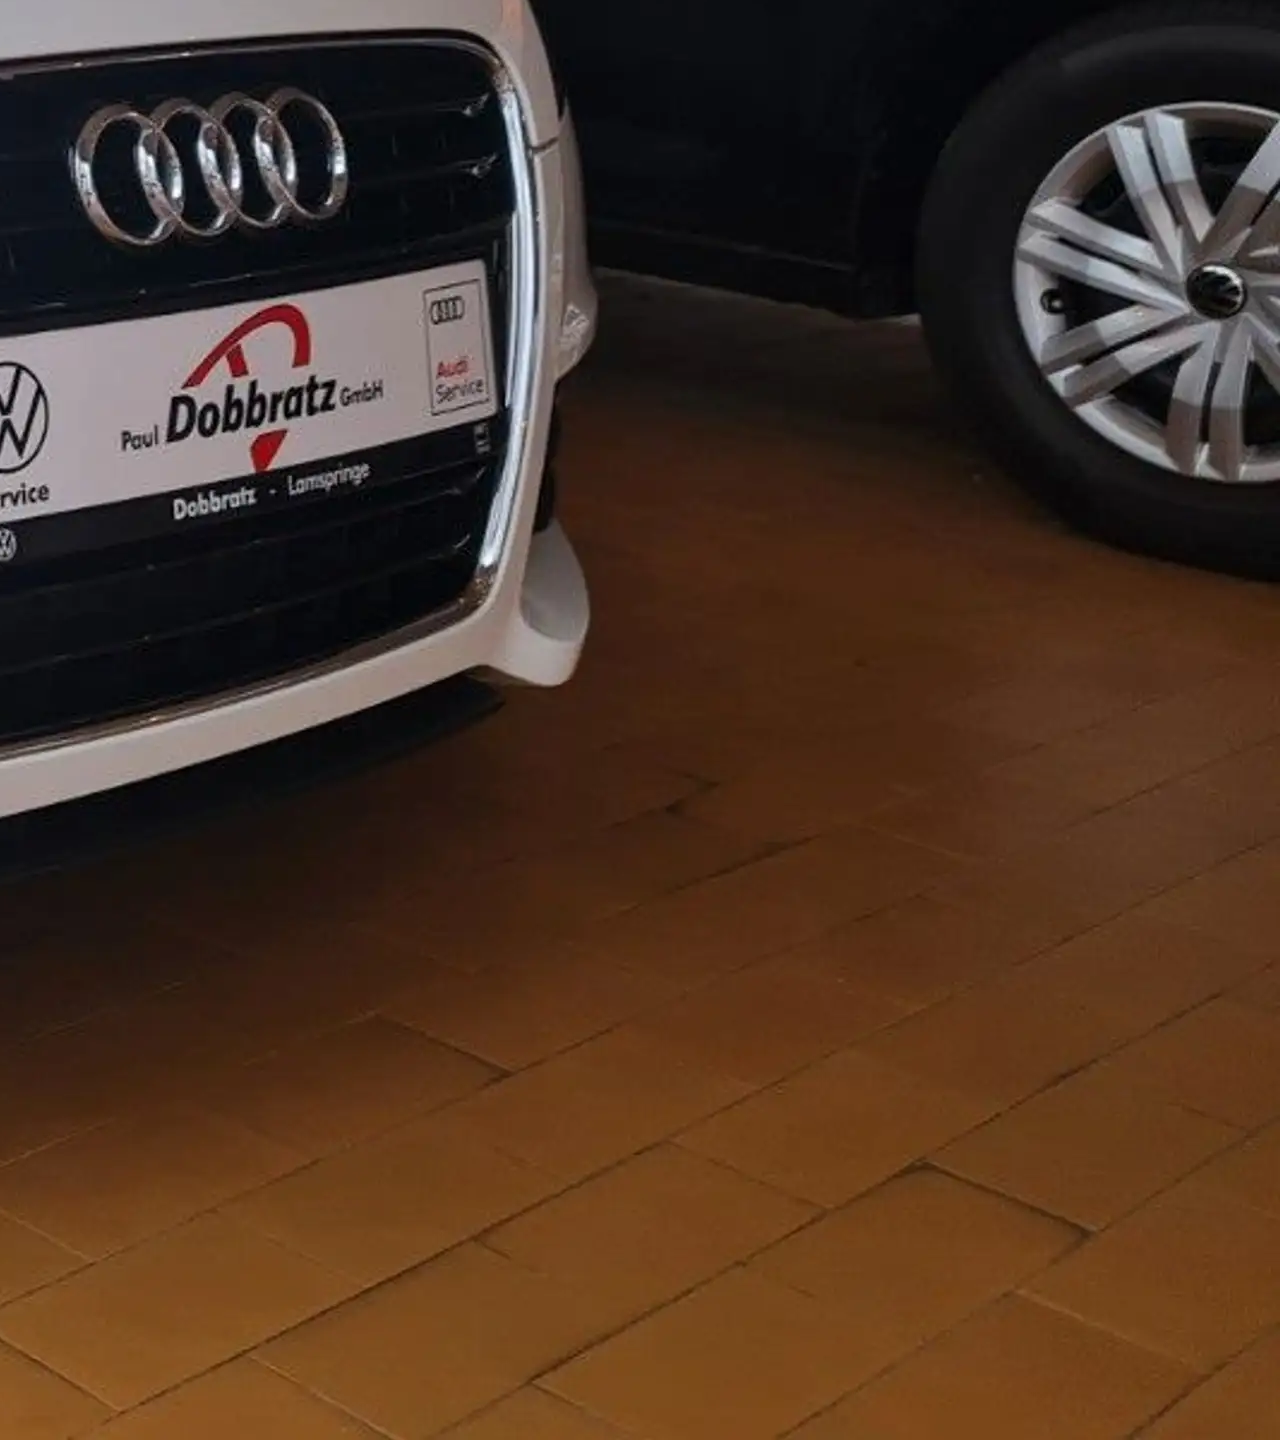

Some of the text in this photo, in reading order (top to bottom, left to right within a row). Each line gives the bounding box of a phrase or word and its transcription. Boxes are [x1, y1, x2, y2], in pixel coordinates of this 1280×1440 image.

[436, 356, 473, 379] Audi
[435, 379, 484, 403] Service
[121, 375, 384, 451] Paul Dobbratz GmbH
[173, 486, 257, 520] Dobbratz
[288, 462, 371, 495] Lamspringe
